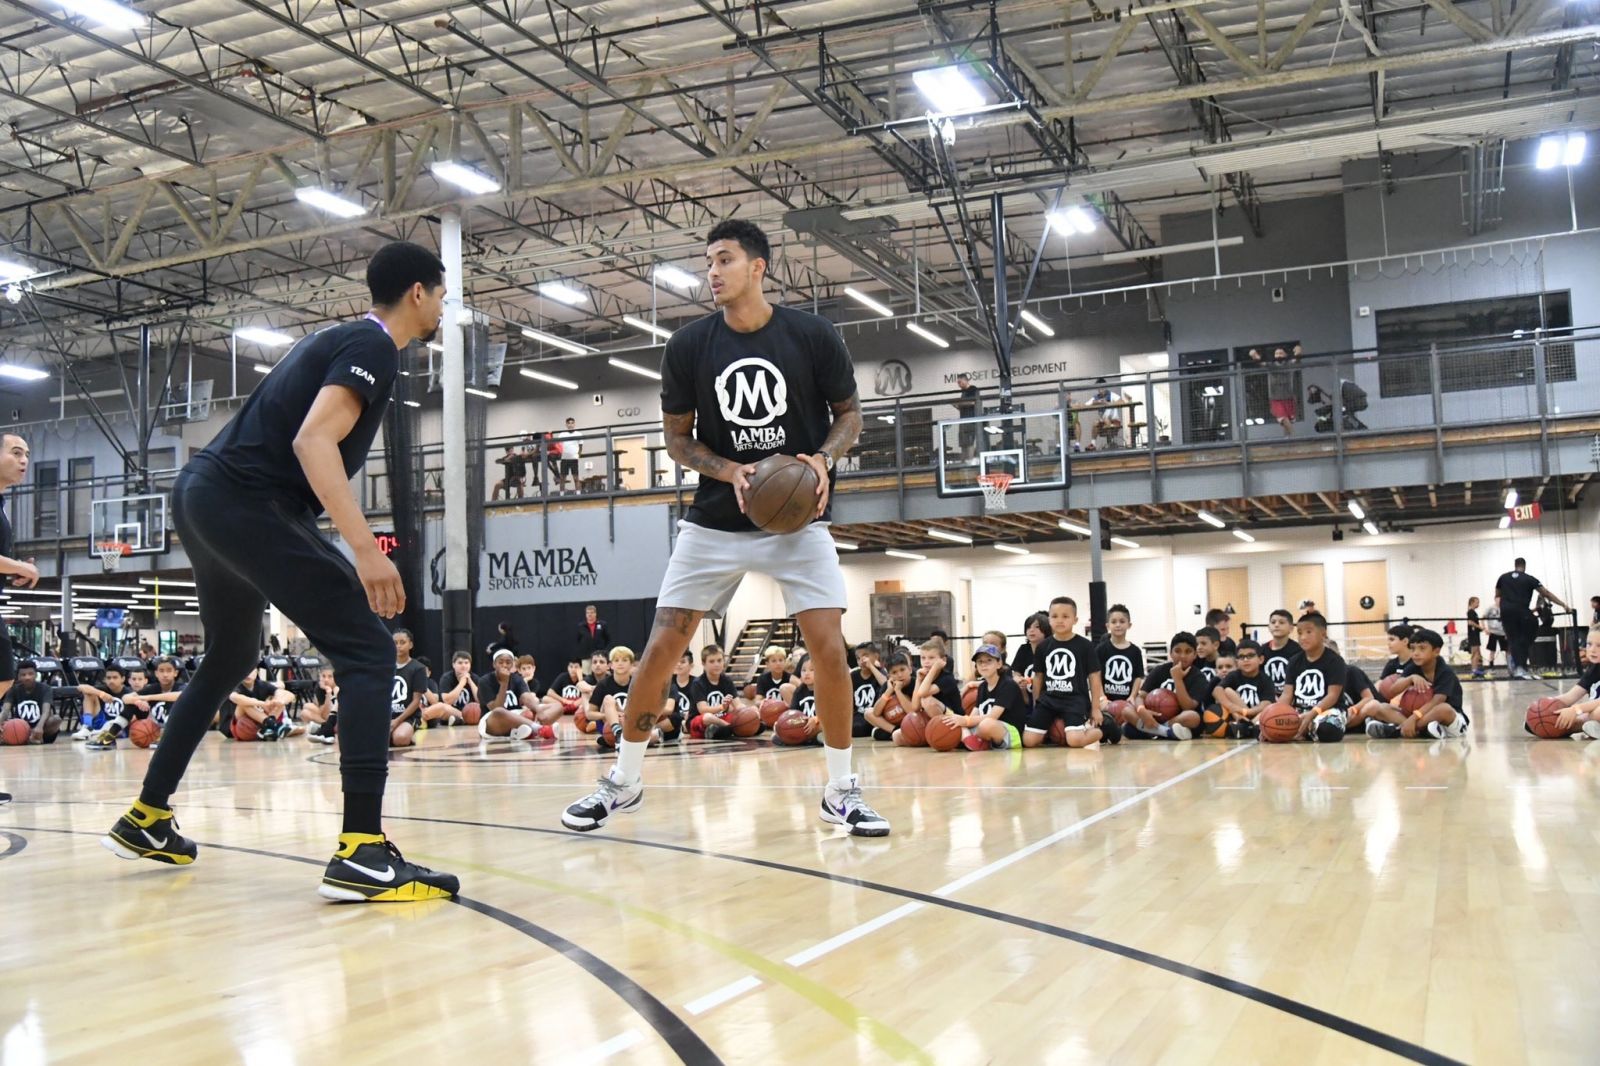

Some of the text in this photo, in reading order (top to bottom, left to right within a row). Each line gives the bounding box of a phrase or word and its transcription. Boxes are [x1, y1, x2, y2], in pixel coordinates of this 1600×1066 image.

[350, 365, 376, 385] TEAM
[944, 361, 1067, 384] MIDSET DELOPMENT
[1513, 503, 1534, 521] EXIT
[488, 546, 597, 578] MAMBA
[488, 572, 599, 591] SPORTS ACADEMY
